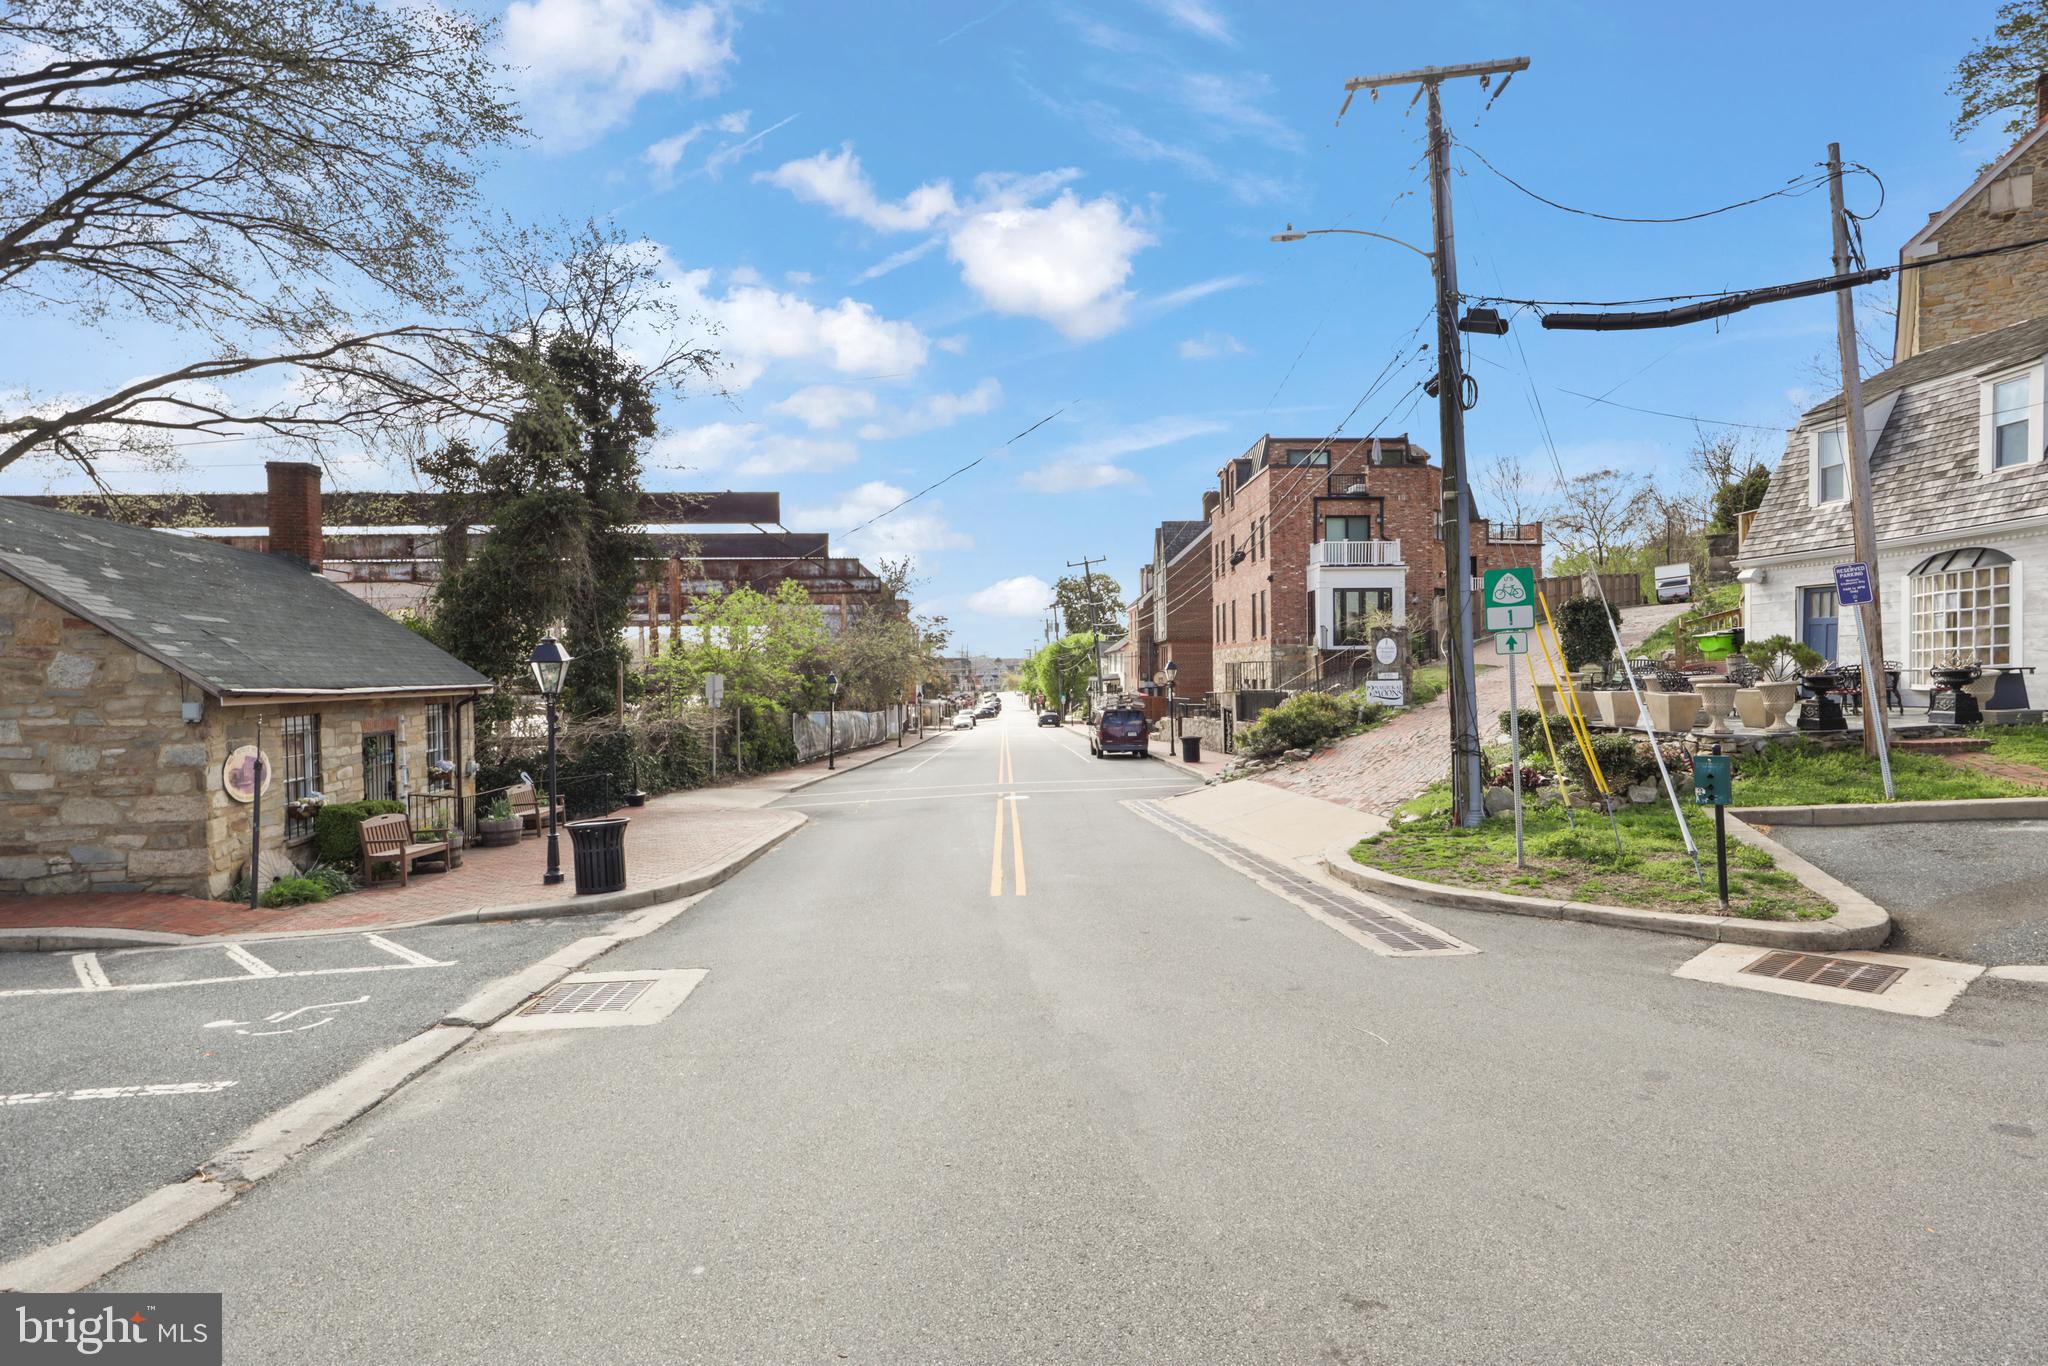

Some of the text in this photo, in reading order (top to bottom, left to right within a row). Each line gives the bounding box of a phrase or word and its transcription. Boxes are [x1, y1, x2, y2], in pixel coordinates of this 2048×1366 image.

[1836, 565, 1865, 574] RESERVED
[1839, 570, 1864, 579] PARKING
[1507, 609, 1513, 626] 1
